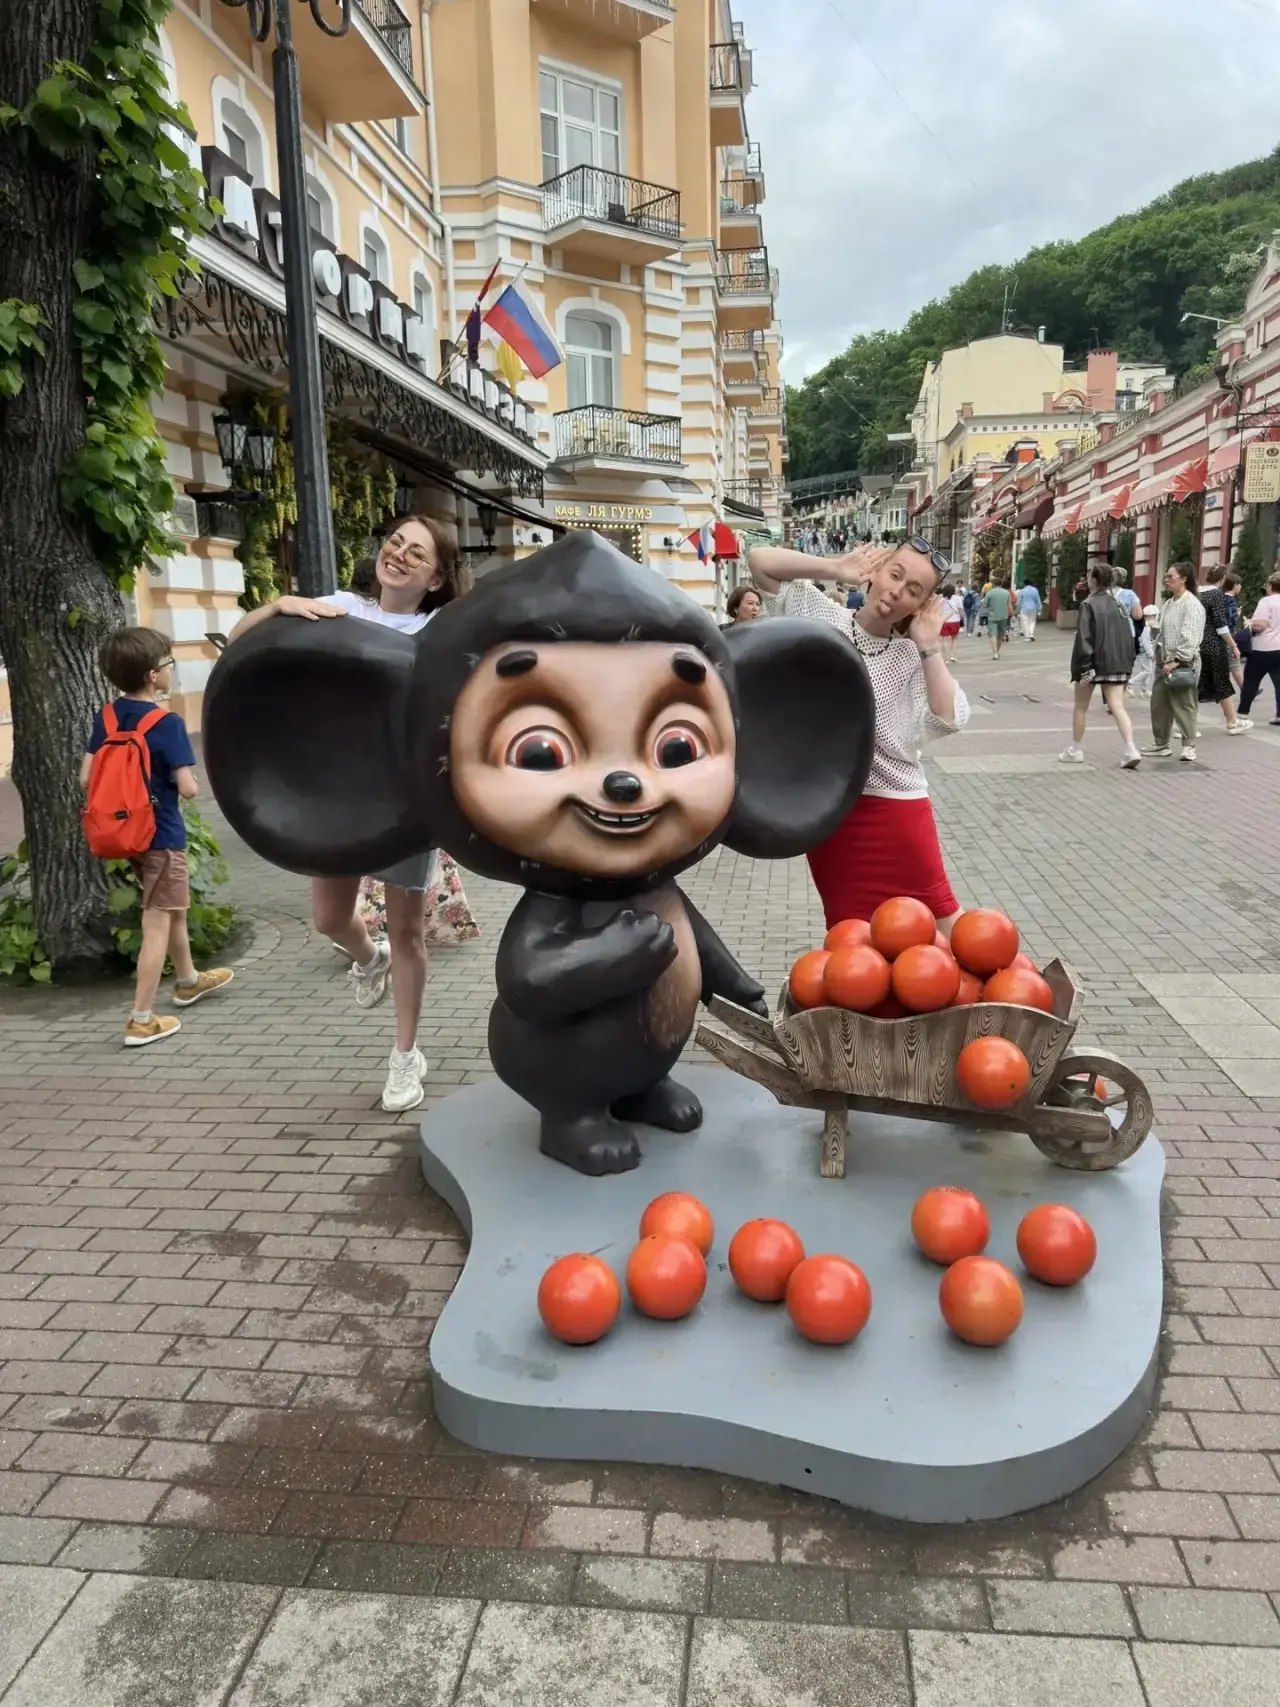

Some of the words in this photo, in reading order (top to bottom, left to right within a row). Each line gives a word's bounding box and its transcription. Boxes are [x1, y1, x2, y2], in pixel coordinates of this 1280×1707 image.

[554, 505, 581, 517] КАФЕ
[588, 505, 605, 518] ЛЯ
[611, 506, 653, 520] ГУРМЭ
